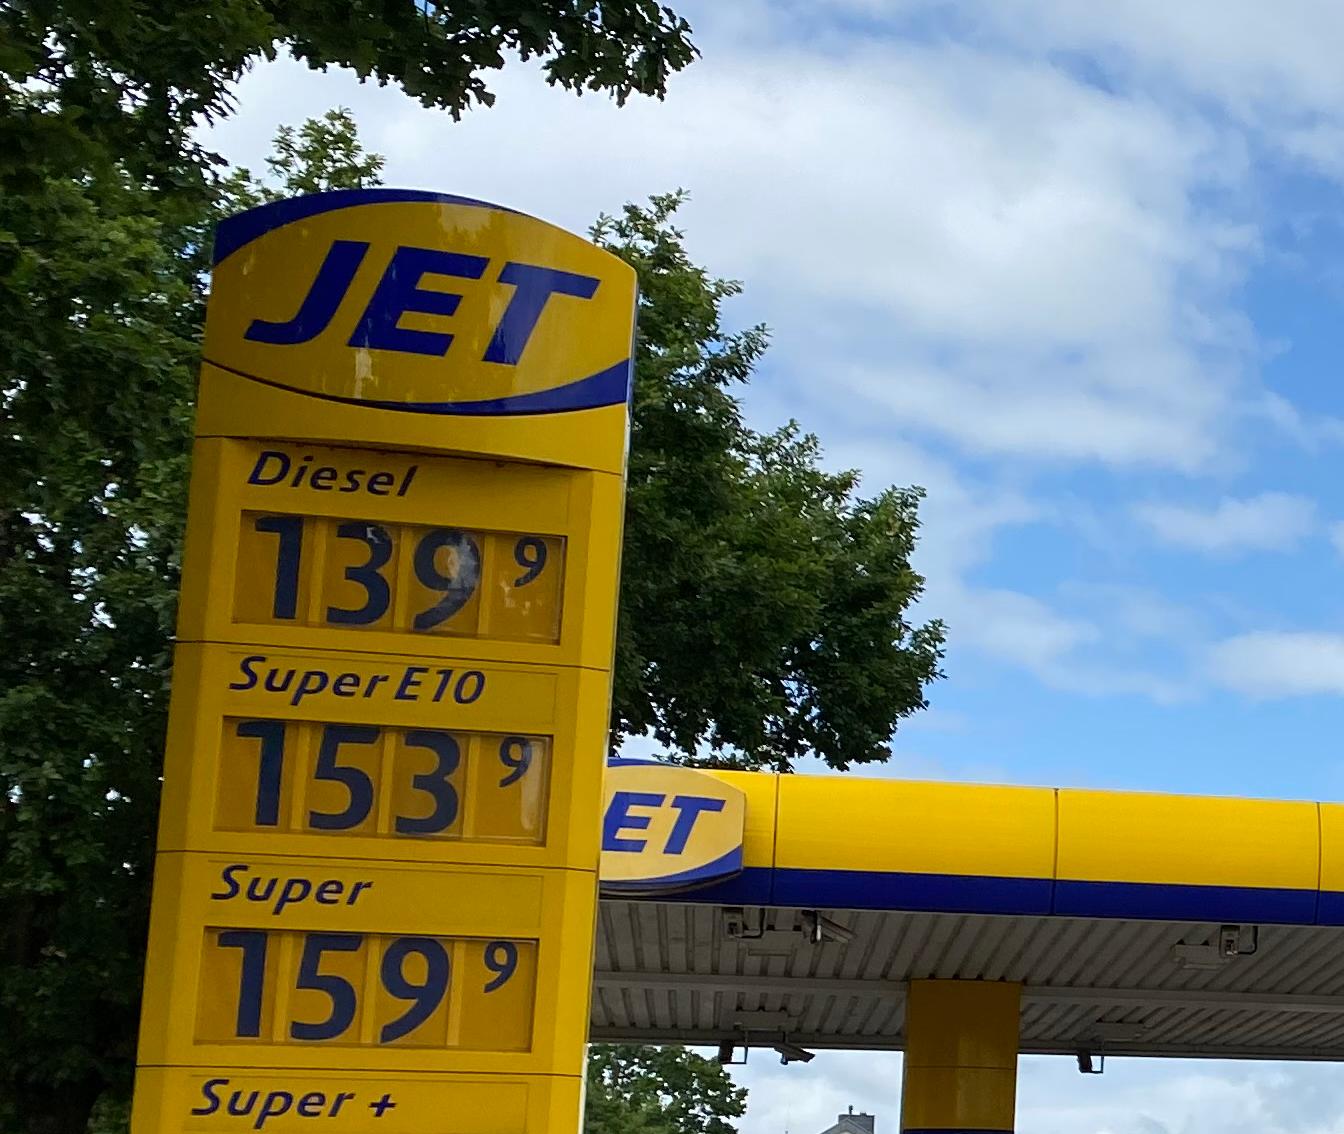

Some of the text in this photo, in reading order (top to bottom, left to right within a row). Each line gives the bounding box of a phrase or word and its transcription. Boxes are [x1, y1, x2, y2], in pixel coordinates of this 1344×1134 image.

[243, 239, 600, 366] JET
[246, 449, 418, 498] Diesel
[253, 515, 548, 631] 139 9
[229, 655, 486, 705] Super E10
[235, 719, 531, 834] 153 9
[601, 791, 726, 855] ET
[211, 864, 373, 914] Super
[217, 930, 519, 1044] 159 9
[191, 1078, 397, 1129] Super +
